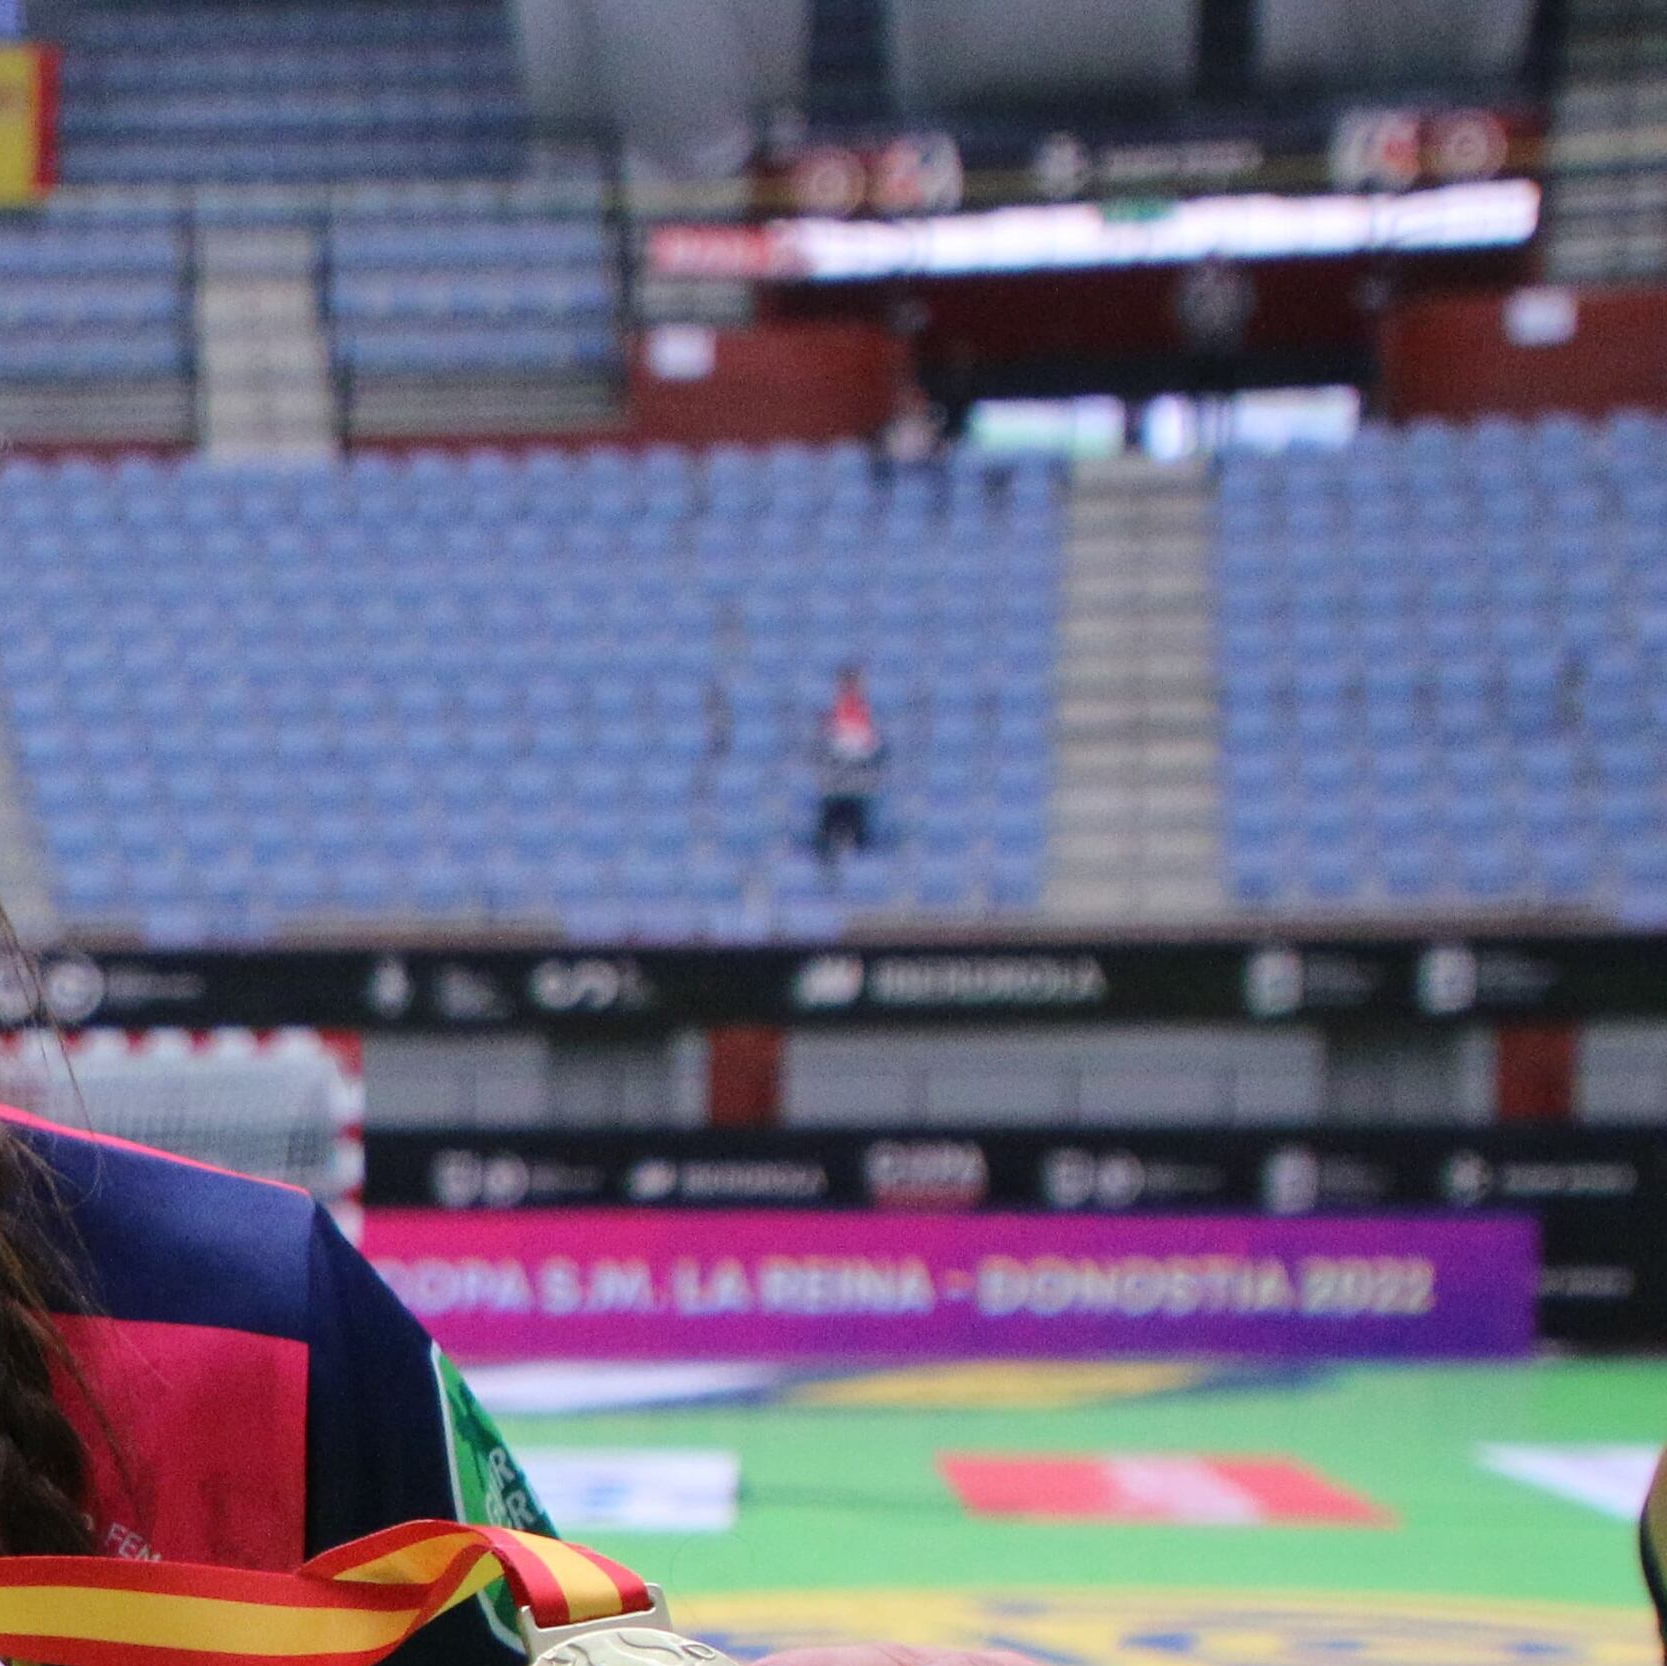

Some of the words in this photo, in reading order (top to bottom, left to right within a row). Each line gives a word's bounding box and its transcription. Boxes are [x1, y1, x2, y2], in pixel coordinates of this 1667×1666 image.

[672, 1255, 753, 1316] LA
[761, 1254, 935, 1316] REINA
[977, 1254, 1299, 1318] DONOSTIA
[1300, 1254, 1438, 1317] 2022
